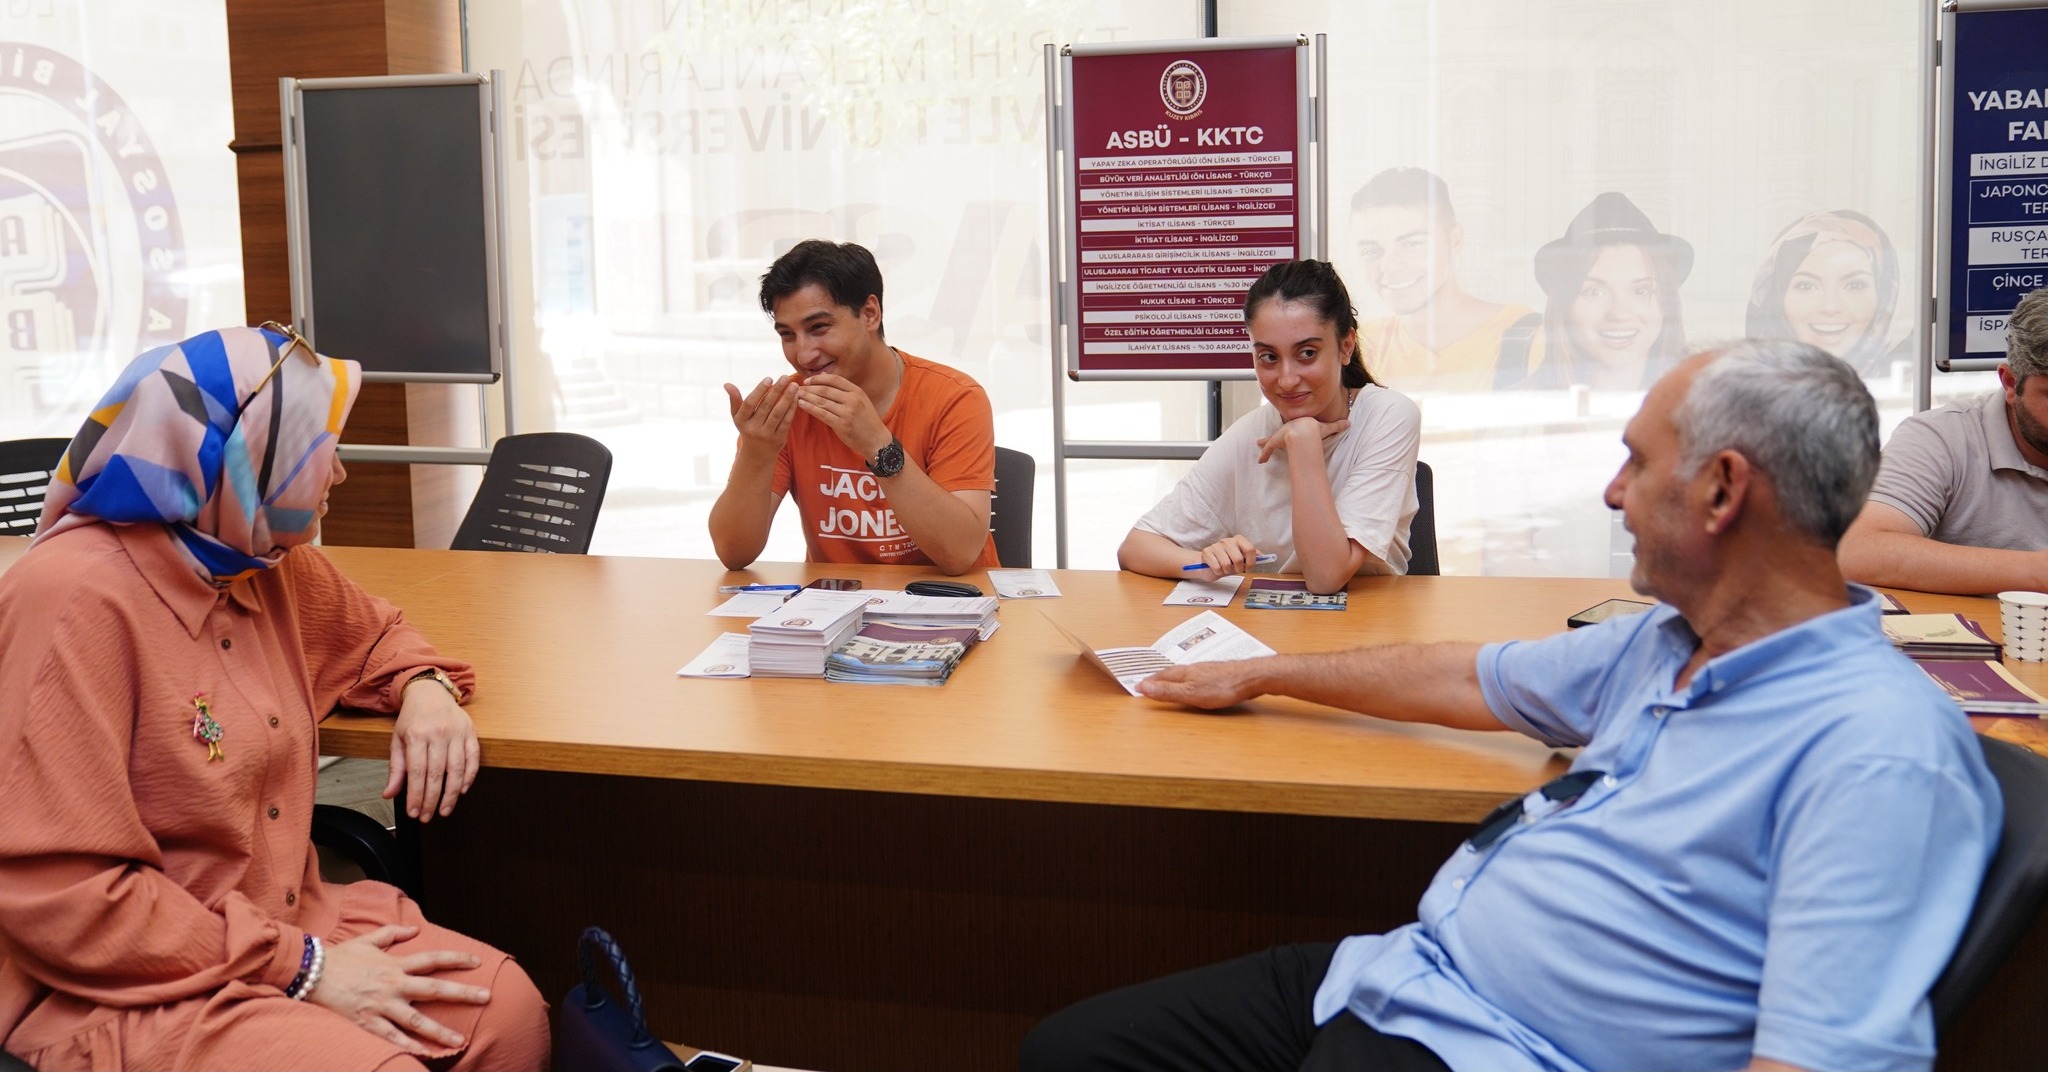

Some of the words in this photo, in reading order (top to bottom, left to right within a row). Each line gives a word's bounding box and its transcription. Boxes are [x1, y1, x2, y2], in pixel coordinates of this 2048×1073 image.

[1106, 124, 1171, 149] ASBÜ
[1197, 126, 1264, 146] KKTC
[1138, 157, 1197, 166] OPERATÖRLÜĞÜ
[1215, 156, 1240, 164] LİSANS
[1248, 155, 1281, 163] TÜRKÇE)
[1980, 155, 2036, 170] İNGİLİZ
[1099, 175, 1125, 183] BÜYÜK
[1126, 174, 1143, 182] VERİ
[1144, 172, 1189, 181] ANALİSTLİĞİ
[1206, 172, 1232, 180] LİSANS
[1239, 171, 1272, 179] TÜRKÇE)
[1204, 188, 1232, 196] (LİSANS
[1240, 187, 1272, 195] TÜRKÇE)
[1097, 206, 1130, 214] YÖNETİM
[1131, 205, 1157, 213] BİLİŞİM
[1158, 204, 1200, 212] SİSTEMLERİ
[1201, 203, 1230, 211] (LİSANS
[1237, 202, 1276, 210] İNGİLİZCE)
[1134, 236, 1163, 244] İKTİSAT
[1164, 235, 1193, 243] (LİSANS
[1200, 234, 1239, 242] İNGİLİZCE)
[1991, 230, 2048, 245] RUSÇA
[1155, 251, 1201, 259] GİRİŞİMCİLİK
[1238, 249, 1276, 257] İNGİLİZCE)
[1183, 265, 1216, 273] LOJİSTİK
[1217, 264, 1247, 273] (LİSANS
[1253, 264, 1271, 272] İNGİ
[1132, 281, 1186, 290] ÖĞRETMENLİĞİ
[1992, 273, 2043, 291] ÇİNCE
[1167, 297, 1196, 305] (LİSANS
[1203, 296, 1235, 304] TÜRKÇE)
[1173, 312, 1202, 320] (LİSANS
[1210, 312, 1241, 320] TÜRKÇE)
[1104, 328, 1123, 336] ÖZEL
[1124, 327, 1148, 336] EĞİTİM
[1150, 327, 1204, 336] ÖĞRETMENLİĞİ
[1205, 327, 1234, 335] (LİSANS
[1128, 343, 1161, 351] İLAHİYAT
[820, 507, 905, 537] JONE
